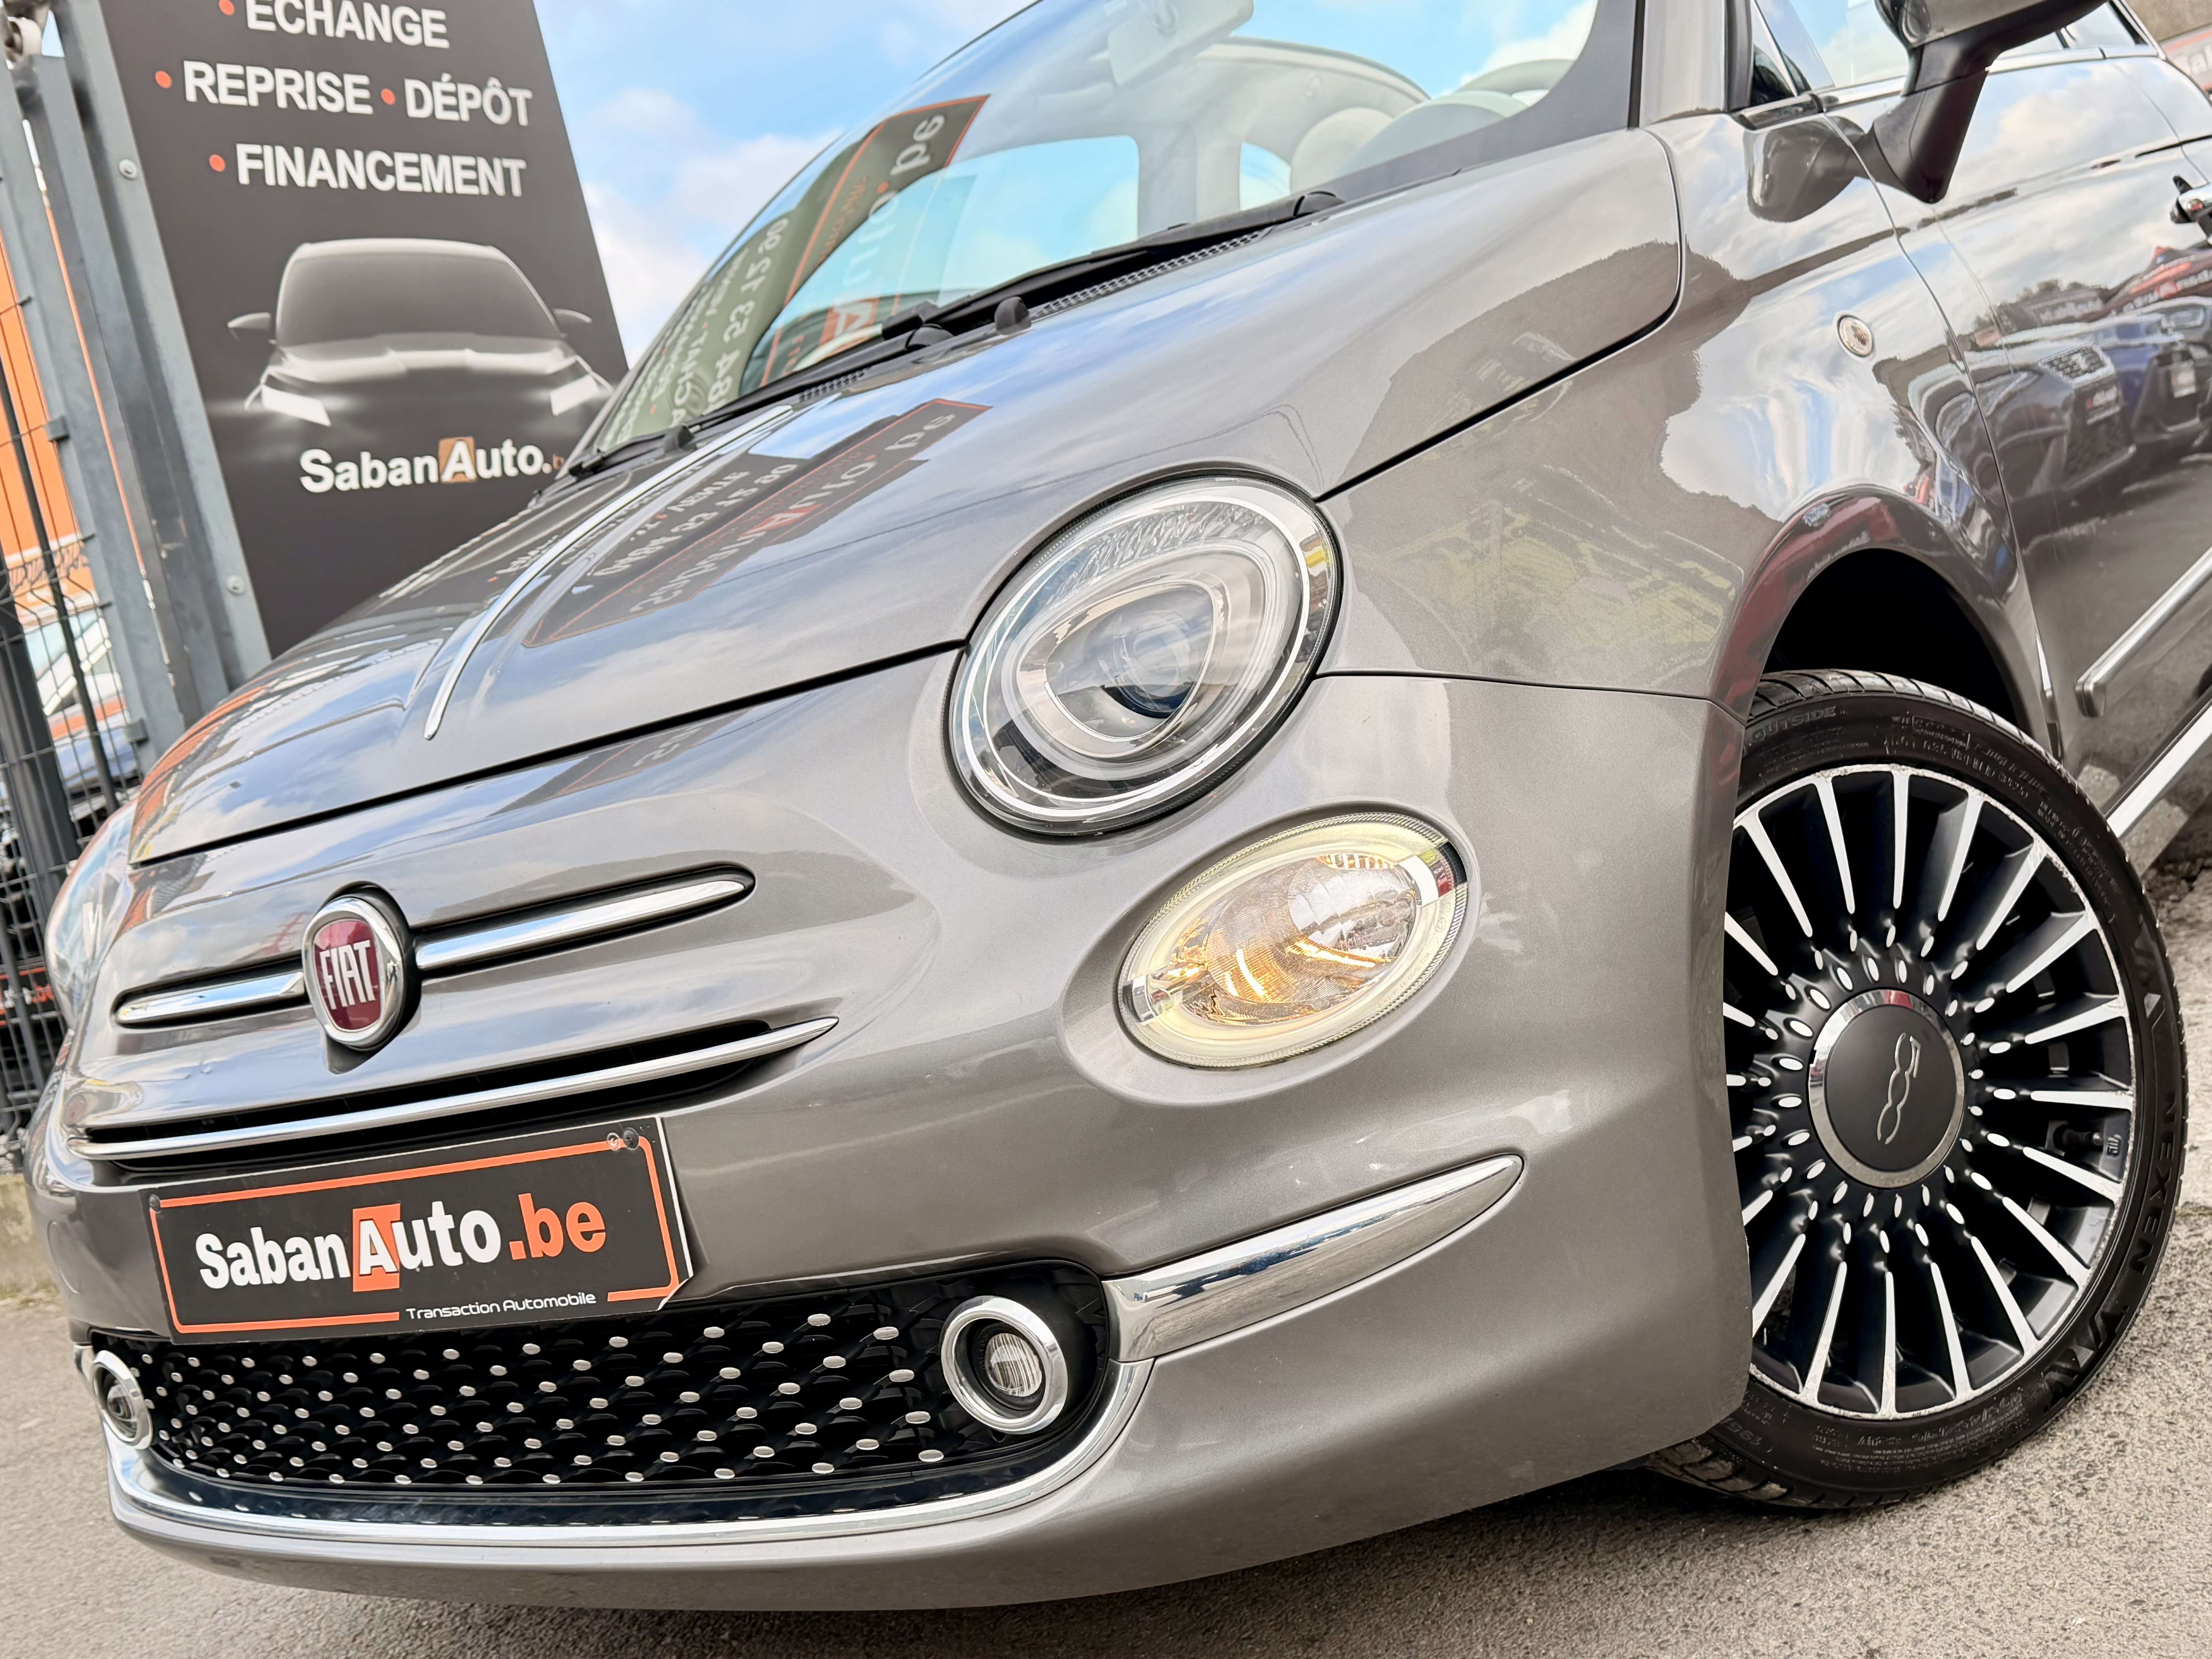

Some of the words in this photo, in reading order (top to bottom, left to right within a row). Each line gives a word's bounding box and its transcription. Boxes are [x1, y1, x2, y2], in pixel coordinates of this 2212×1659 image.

[183, 60, 373, 115] REPRISE
[404, 73, 533, 127] DÉPÔT
[236, 143, 526, 198] FINANCEMENT
[1752, 705, 1836, 742] OUTSIDE
[319, 939, 376, 1010] FIAT
[2130, 1091, 2177, 1276] NEXEN
[195, 1193, 606, 1290] SabanAuto.be
[405, 1302, 500, 1319] Transaction
[503, 1292, 597, 1312] Automobile
